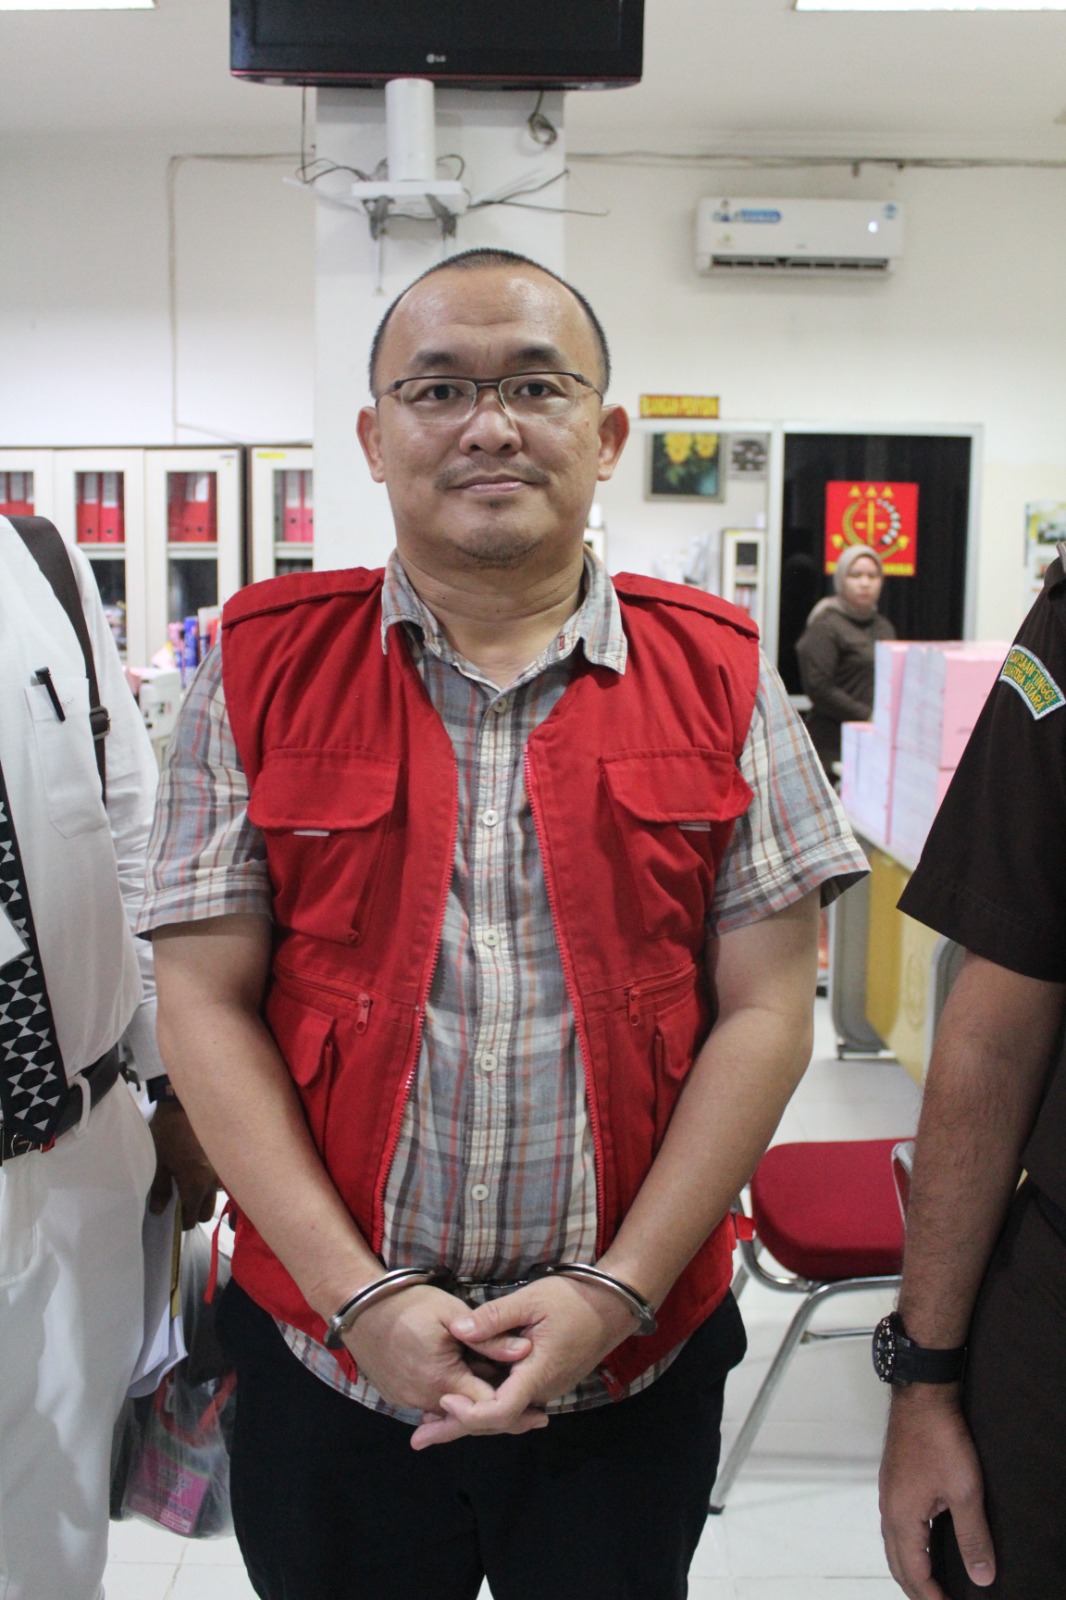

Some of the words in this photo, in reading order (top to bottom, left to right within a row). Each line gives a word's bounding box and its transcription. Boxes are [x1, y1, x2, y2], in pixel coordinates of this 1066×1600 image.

[1003, 664, 1026, 685] TERA
[1024, 681, 1045, 711] UTARA
[1032, 669, 1056, 705] TINGGI
